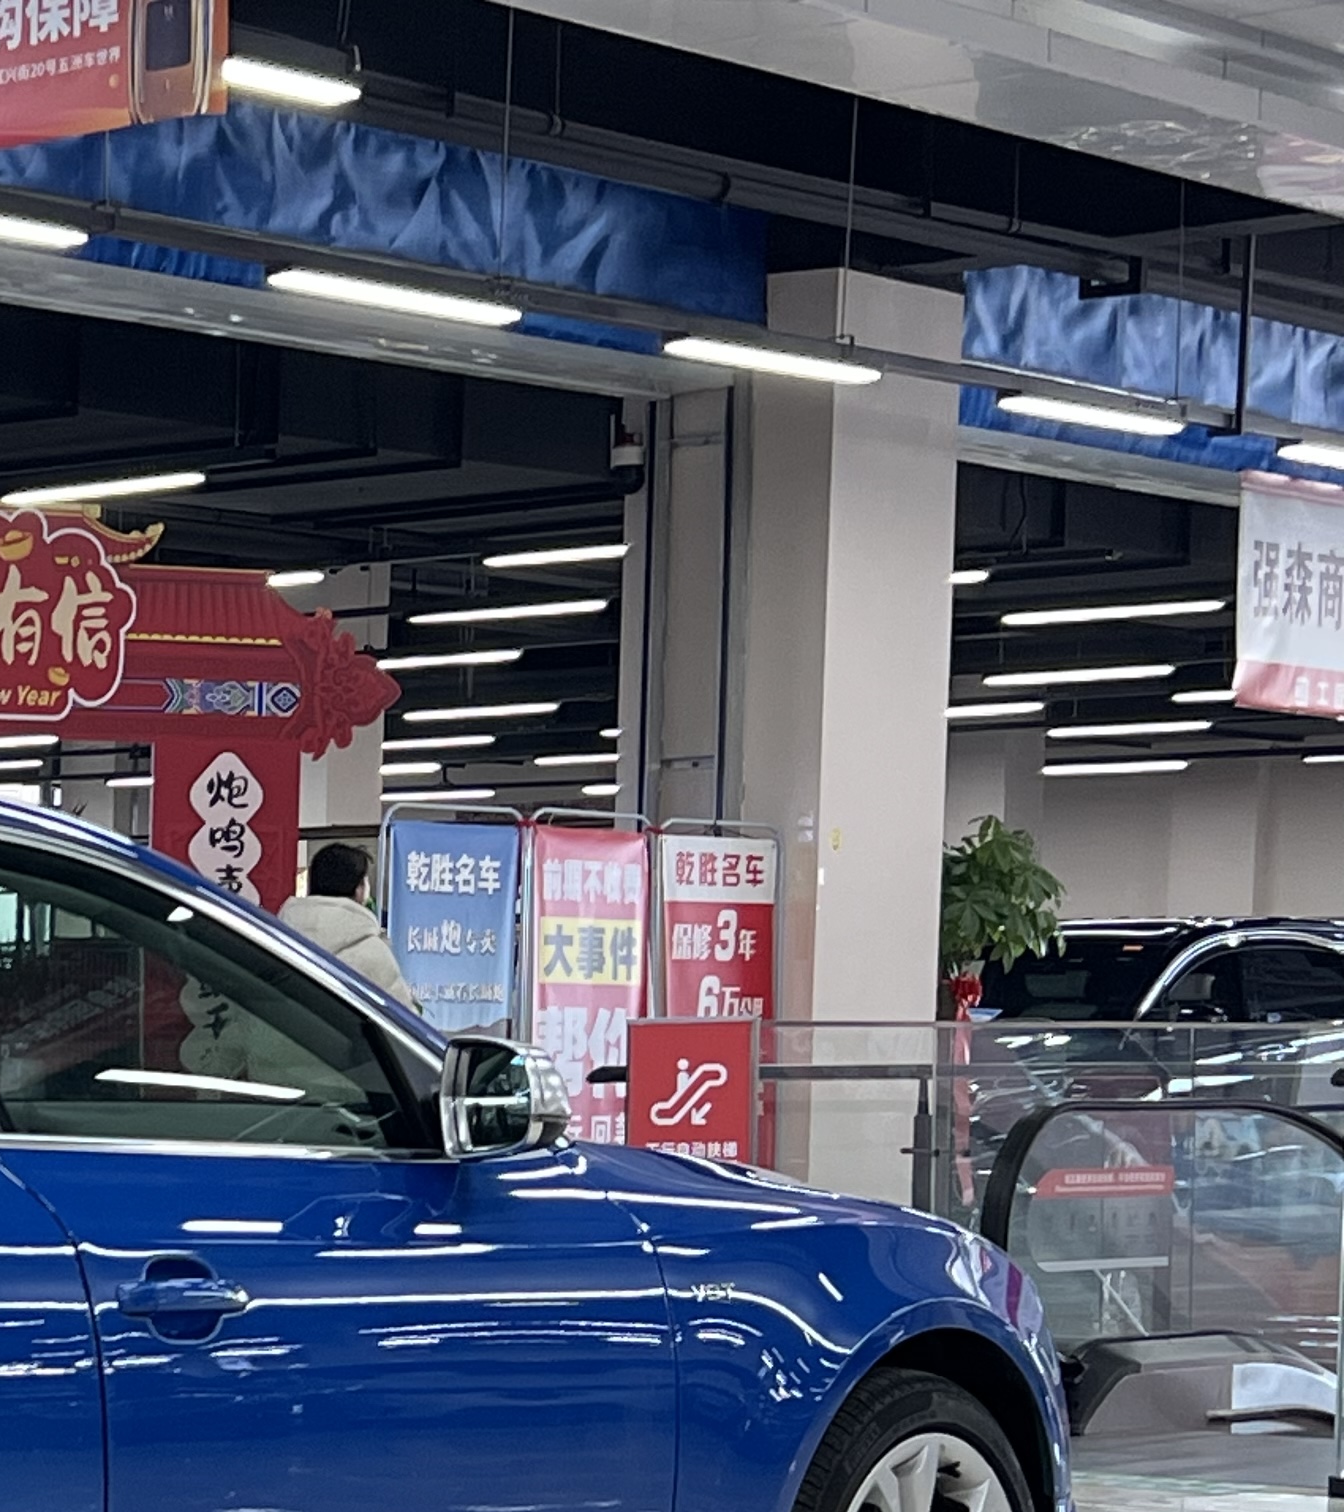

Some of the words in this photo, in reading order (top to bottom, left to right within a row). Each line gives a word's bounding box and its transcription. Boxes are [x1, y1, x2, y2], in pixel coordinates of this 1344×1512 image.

[17, 685, 61, 707] Year
[406, 850, 502, 895] 乾胜名车
[675, 851, 765, 888] 乾胜名车
[543, 924, 638, 981] 大事件
[671, 908, 757, 962] 保修3年
